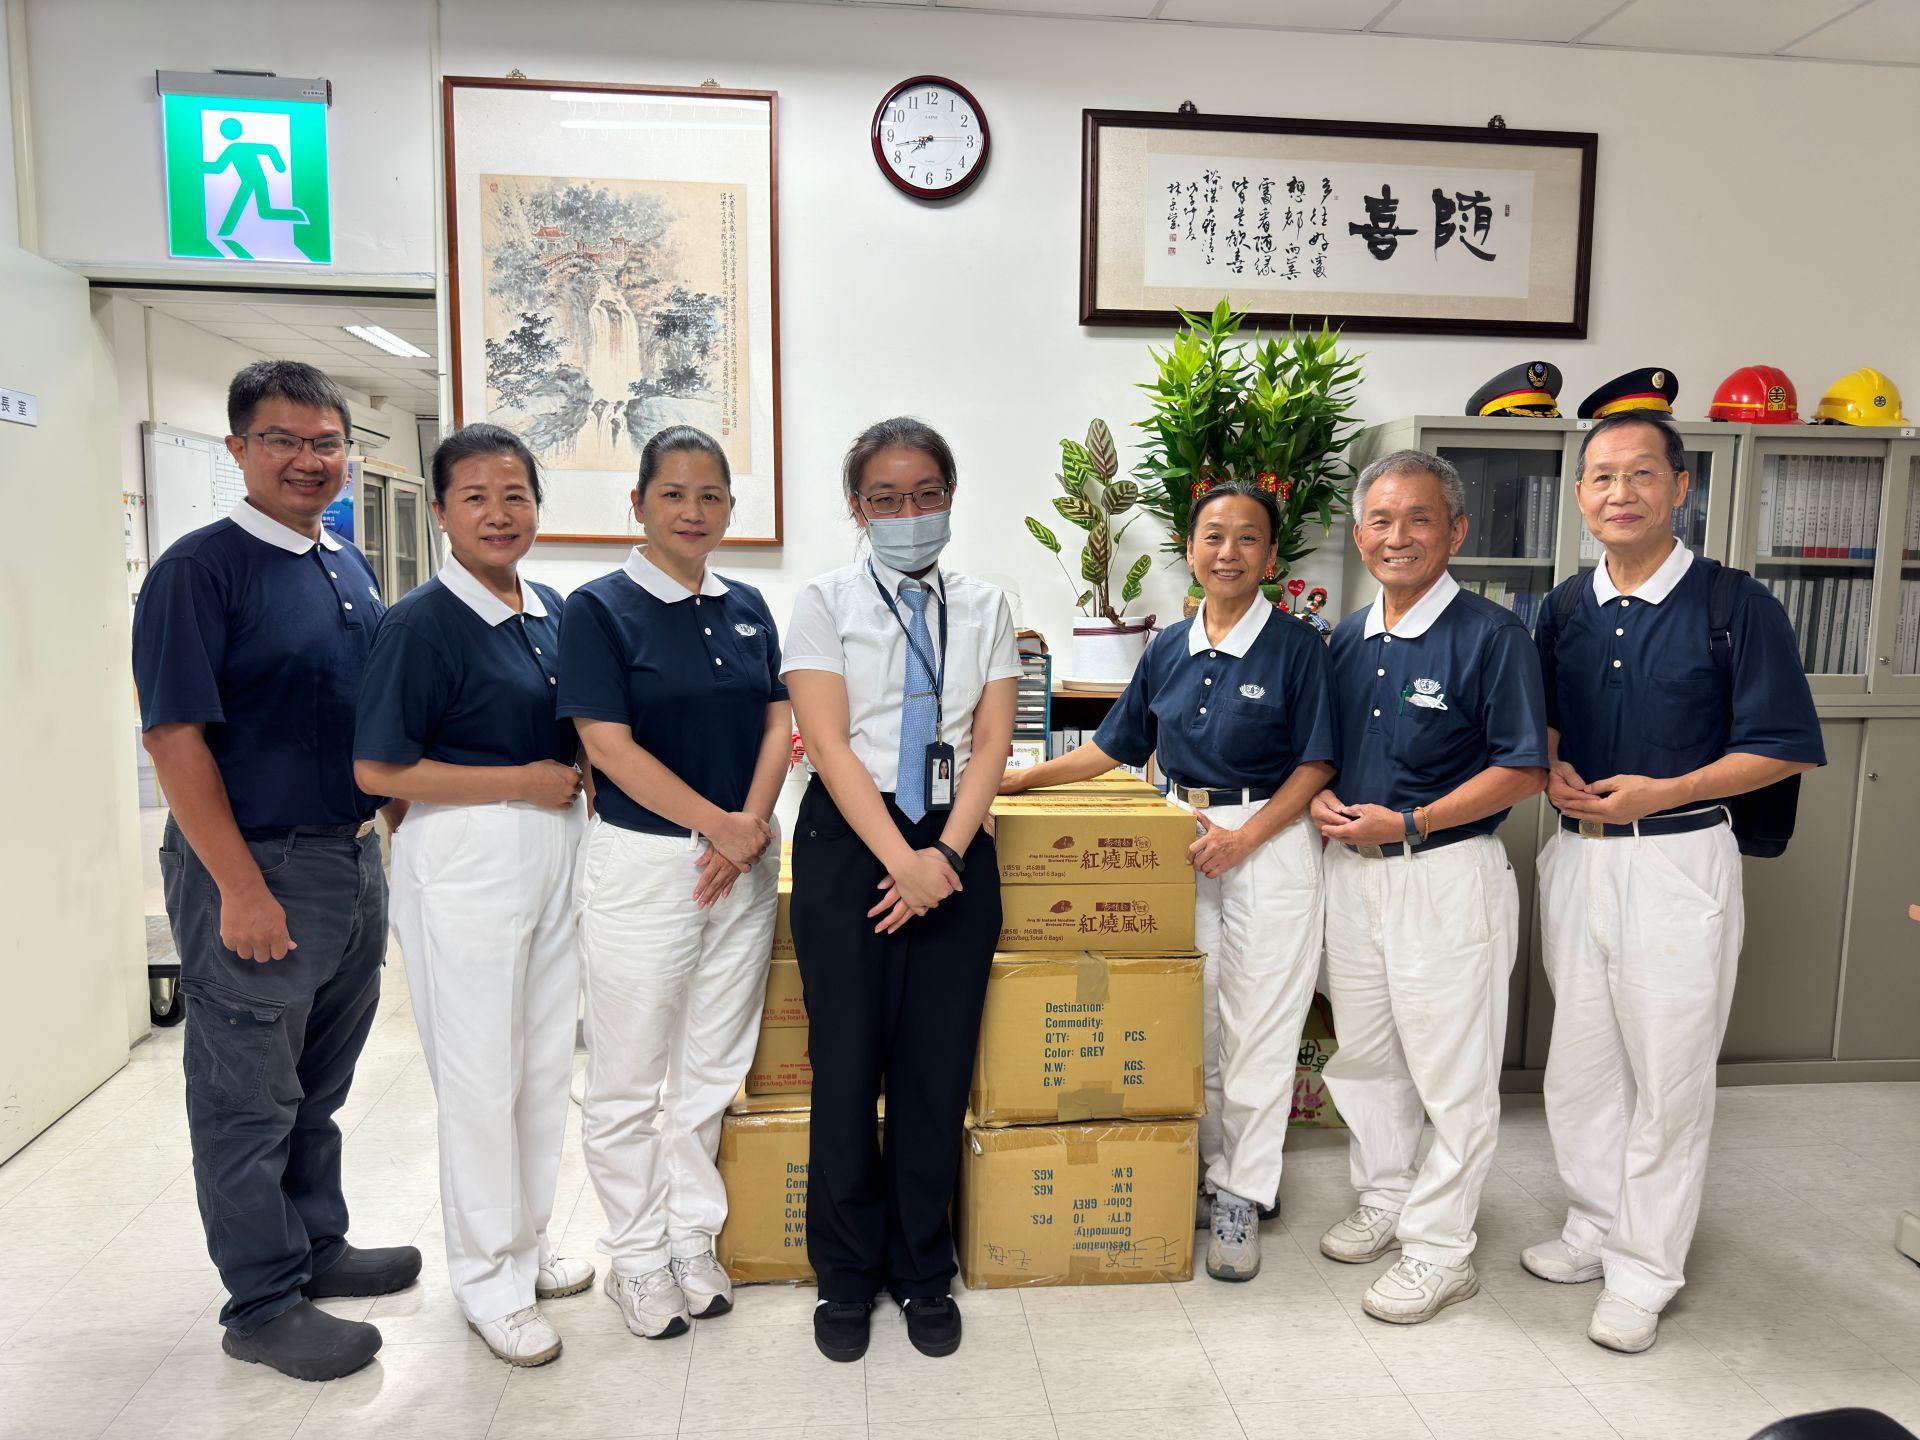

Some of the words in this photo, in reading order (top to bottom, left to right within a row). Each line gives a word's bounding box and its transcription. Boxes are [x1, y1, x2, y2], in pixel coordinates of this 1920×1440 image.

[908, 96, 918, 109] 11
[926, 92, 938, 105] 12
[950, 99, 954, 113] 1
[893, 110, 905, 123] 10
[961, 115, 968, 128] 2
[887, 129, 894, 142] 9
[966, 135, 974, 148] 3
[894, 151, 901, 164] 8
[958, 155, 965, 168] 4
[909, 166, 916, 179] 7
[926, 172, 933, 185] 6
[945, 168, 953, 182] 5
[1348, 184, 1497, 262] 隨喜
[1080, 849, 1160, 871] 紅燒風味
[1077, 912, 1158, 935] 紅燒風味
[1045, 1002, 1105, 1013] Destination:
[1045, 1017, 1104, 1029] Commodity:
[1045, 1033, 1070, 1044] Q'TY:
[1092, 1031, 1104, 1042] 10
[1124, 1030, 1147, 1041] PCS.
[1044, 1047, 1074, 1058] Color:
[1080, 1046, 1105, 1057] GREY
[1044, 1062, 1066, 1072] N.W:
[1124, 1060, 1146, 1071] KGS.
[1043, 1077, 1066, 1087] G.W:
[1123, 1074, 1145, 1085] KGS.
[1032, 1169, 1054, 1180] KGS.
[1111, 1167, 1133, 1178] G.W:
[1032, 1185, 1053, 1196] KGS.
[1111, 1183, 1133, 1193] N.W:
[786, 1193, 807, 1204] Q'TY
[1073, 1199, 1097, 1210] GREY
[1103, 1197, 1132, 1208] Color:
[785, 1207, 807, 1219] Colo
[1074, 1213, 1085, 1224] 10
[1107, 1212, 1132, 1223] Q'TY:
[1031, 1214, 1053, 1225] PCS.
[1073, 1226, 1131, 1238] Commodity:
[1072, 1240, 1131, 1251] Destination:
